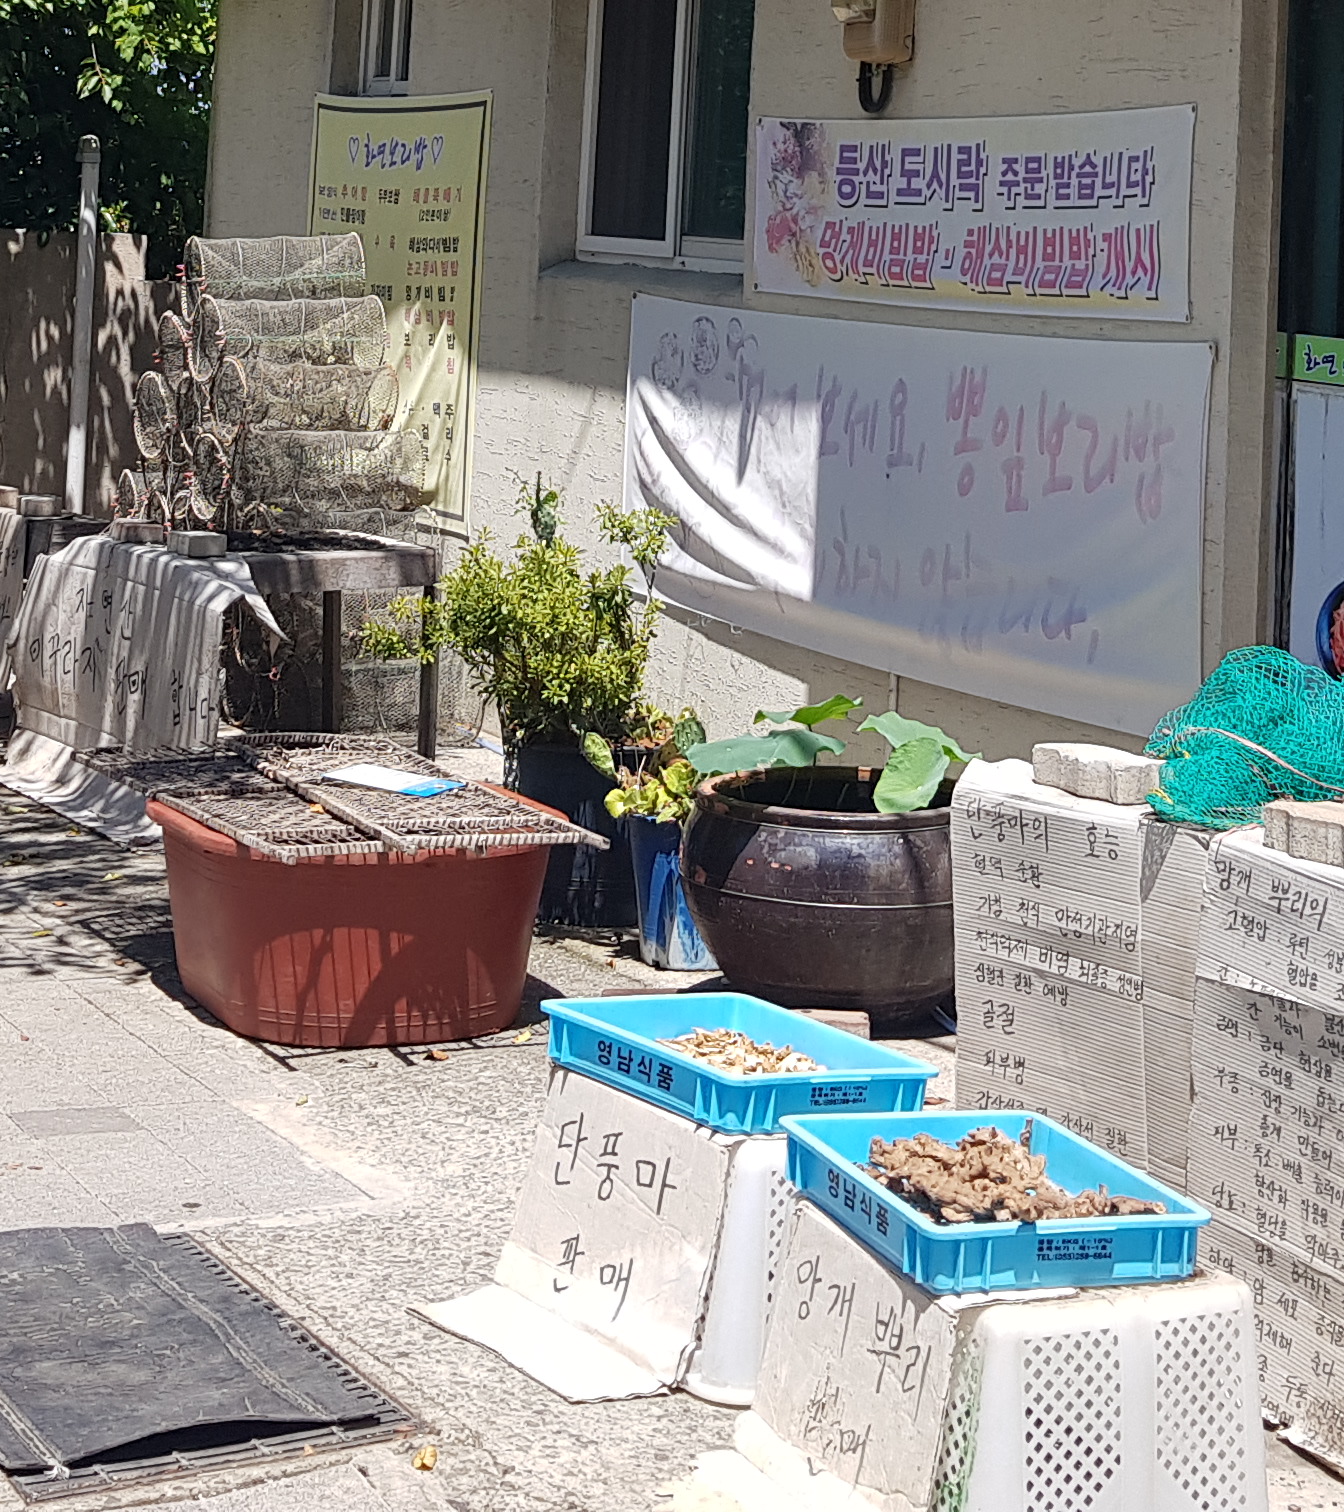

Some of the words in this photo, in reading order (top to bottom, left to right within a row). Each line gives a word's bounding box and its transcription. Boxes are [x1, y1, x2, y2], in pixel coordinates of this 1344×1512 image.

[835, 141, 892, 207] 등산
[894, 140, 987, 211] 도시락
[997, 152, 1047, 209] 주문
[1053, 146, 1154, 209] 받습니다
[819, 219, 937, 289] 멍게비빔밥
[960, 224, 1095, 297] 해삼비빔밥
[1101, 223, 1159, 299] 개시
[597, 1039, 675, 1093] 영남식품
[554, 1112, 678, 1216] 단풍마
[826, 1169, 890, 1236] 영남식품
[867, 1301, 932, 1424] 뿌리
